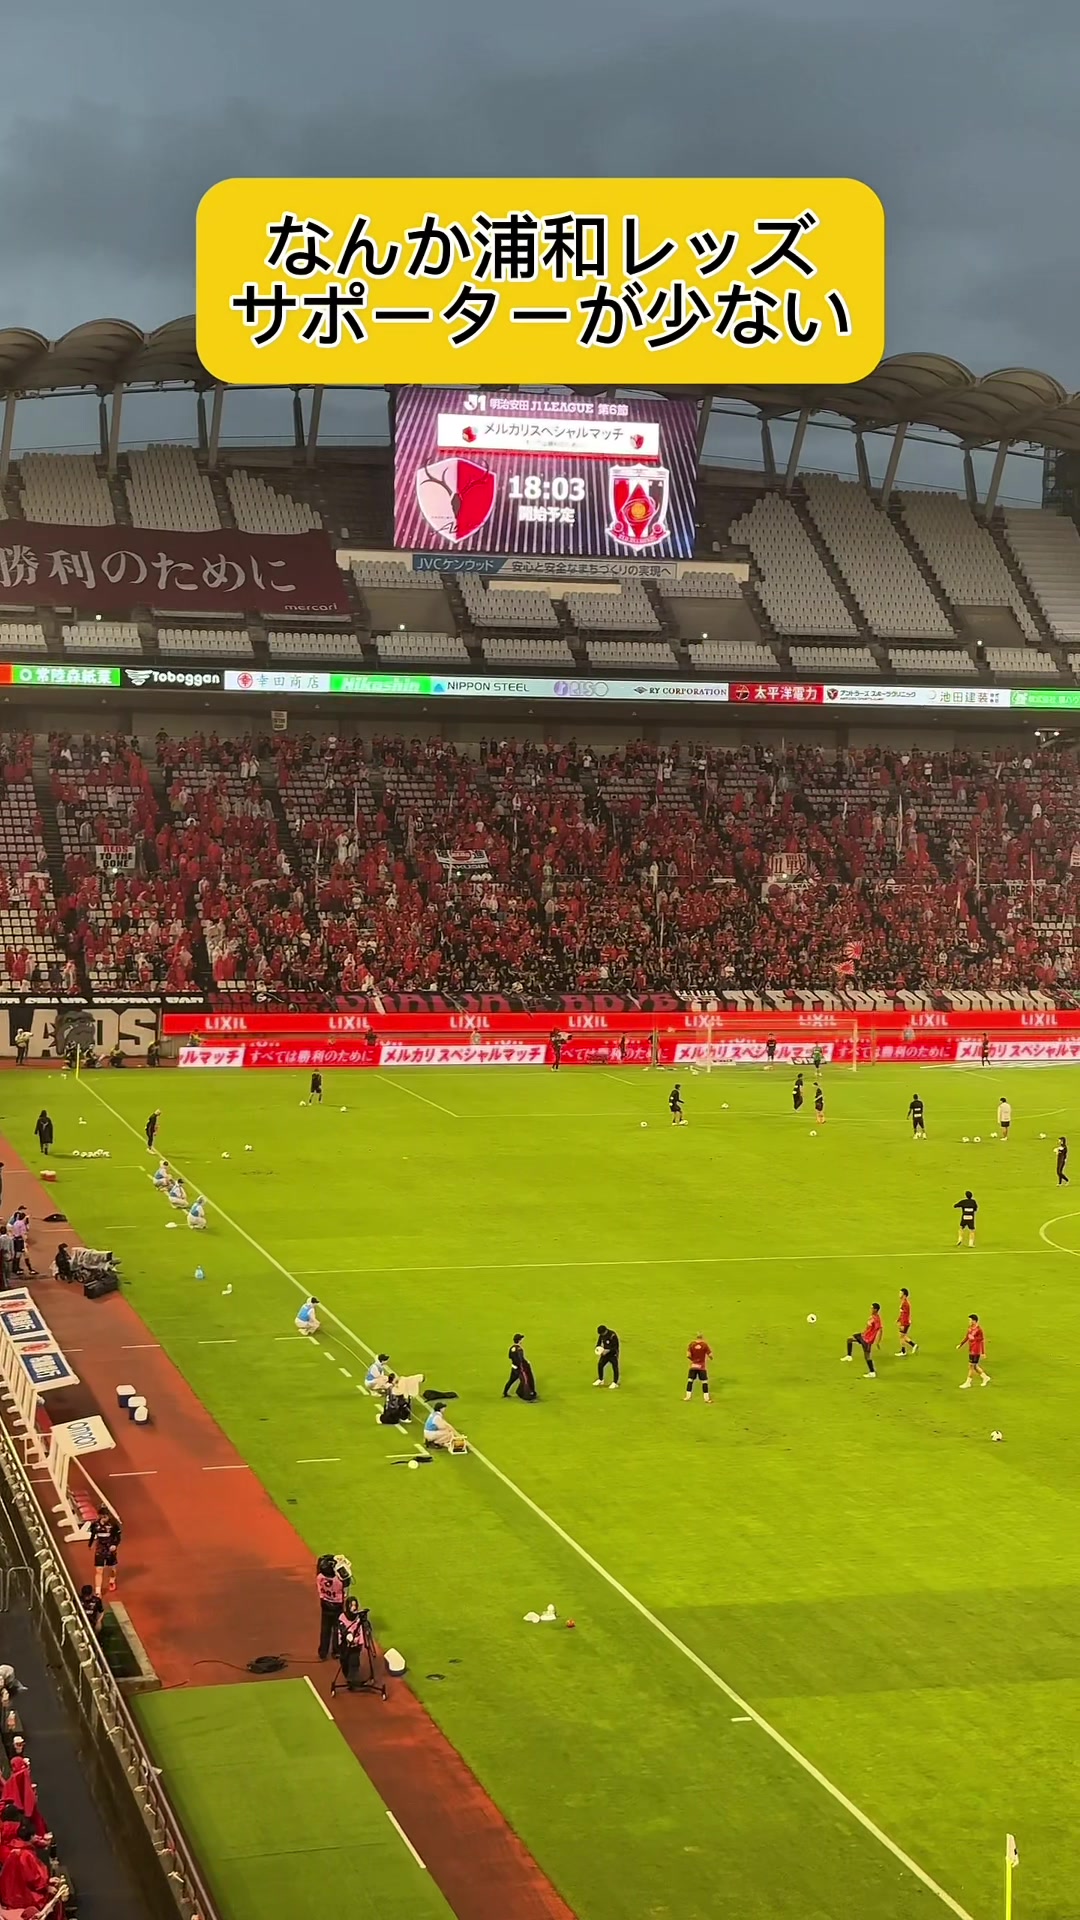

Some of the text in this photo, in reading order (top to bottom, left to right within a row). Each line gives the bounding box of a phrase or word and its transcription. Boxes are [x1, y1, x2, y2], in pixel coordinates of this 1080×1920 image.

[490, 398, 529, 411] 明治安田
[543, 401, 594, 414] LEAGUE
[508, 475, 585, 501] 18:03
[518, 505, 575, 524] 開始予定
[0, 544, 296, 592] 勝利のために
[417, 558, 494, 571] JVCケンウッド
[511, 560, 672, 577] 安心と安全なまちづくりの実現へ
[284, 602, 338, 611] mercari
[153, 670, 220, 685] Toboggan
[447, 681, 529, 692] NIPPON STEEL
[649, 686, 727, 696] RY CORPORATION
[755, 685, 817, 701] 太平洋電力
[116, 852, 133, 860] THE
[205, 1016, 247, 1030] LIXIL
[329, 1016, 370, 1030] LIXIL
[450, 1016, 490, 1029] LIXIL
[568, 1016, 608, 1028] LIXIL
[685, 1015, 723, 1027] LIXIL
[798, 1015, 837, 1027] LIXIL
[911, 1014, 948, 1026] LIXIL
[1021, 1014, 1057, 1026] LIXIL
[250, 1050, 373, 1064] すべては勝利のために
